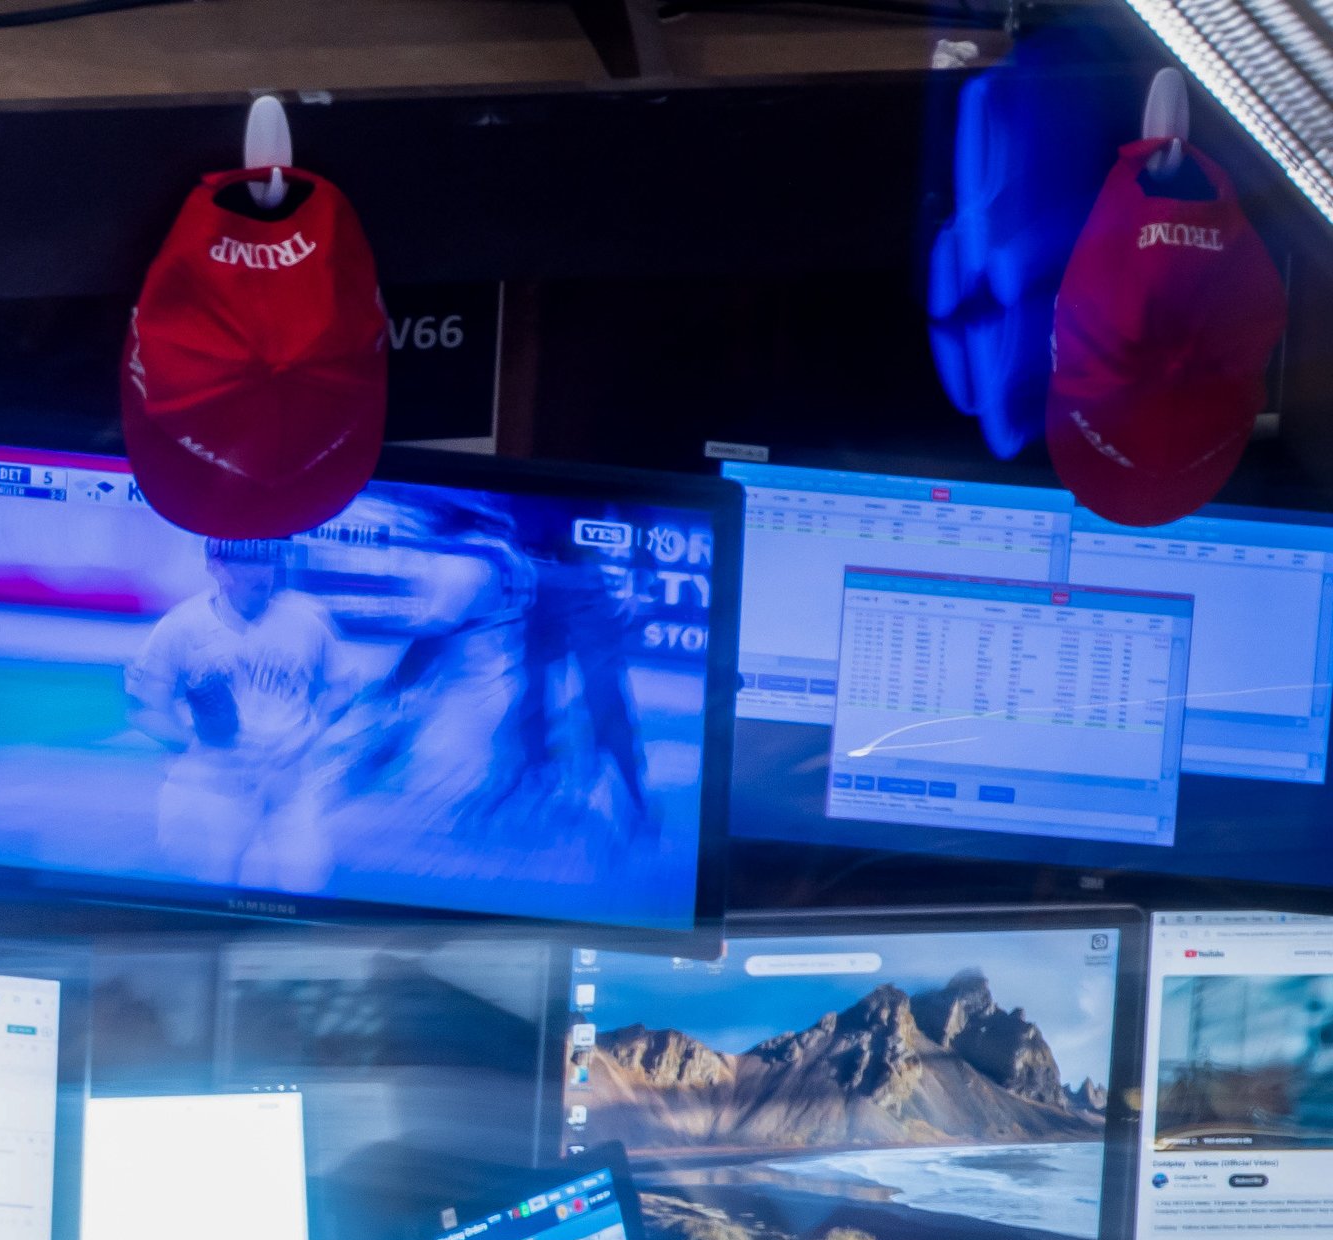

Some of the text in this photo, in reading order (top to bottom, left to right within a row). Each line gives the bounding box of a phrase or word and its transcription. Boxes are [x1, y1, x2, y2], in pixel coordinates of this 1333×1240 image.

[1138, 223, 1223, 250] TRUMP
[209, 231, 317, 270] TRUMP
[0, 466, 23, 481] DET
[584, 526, 623, 542] YES
